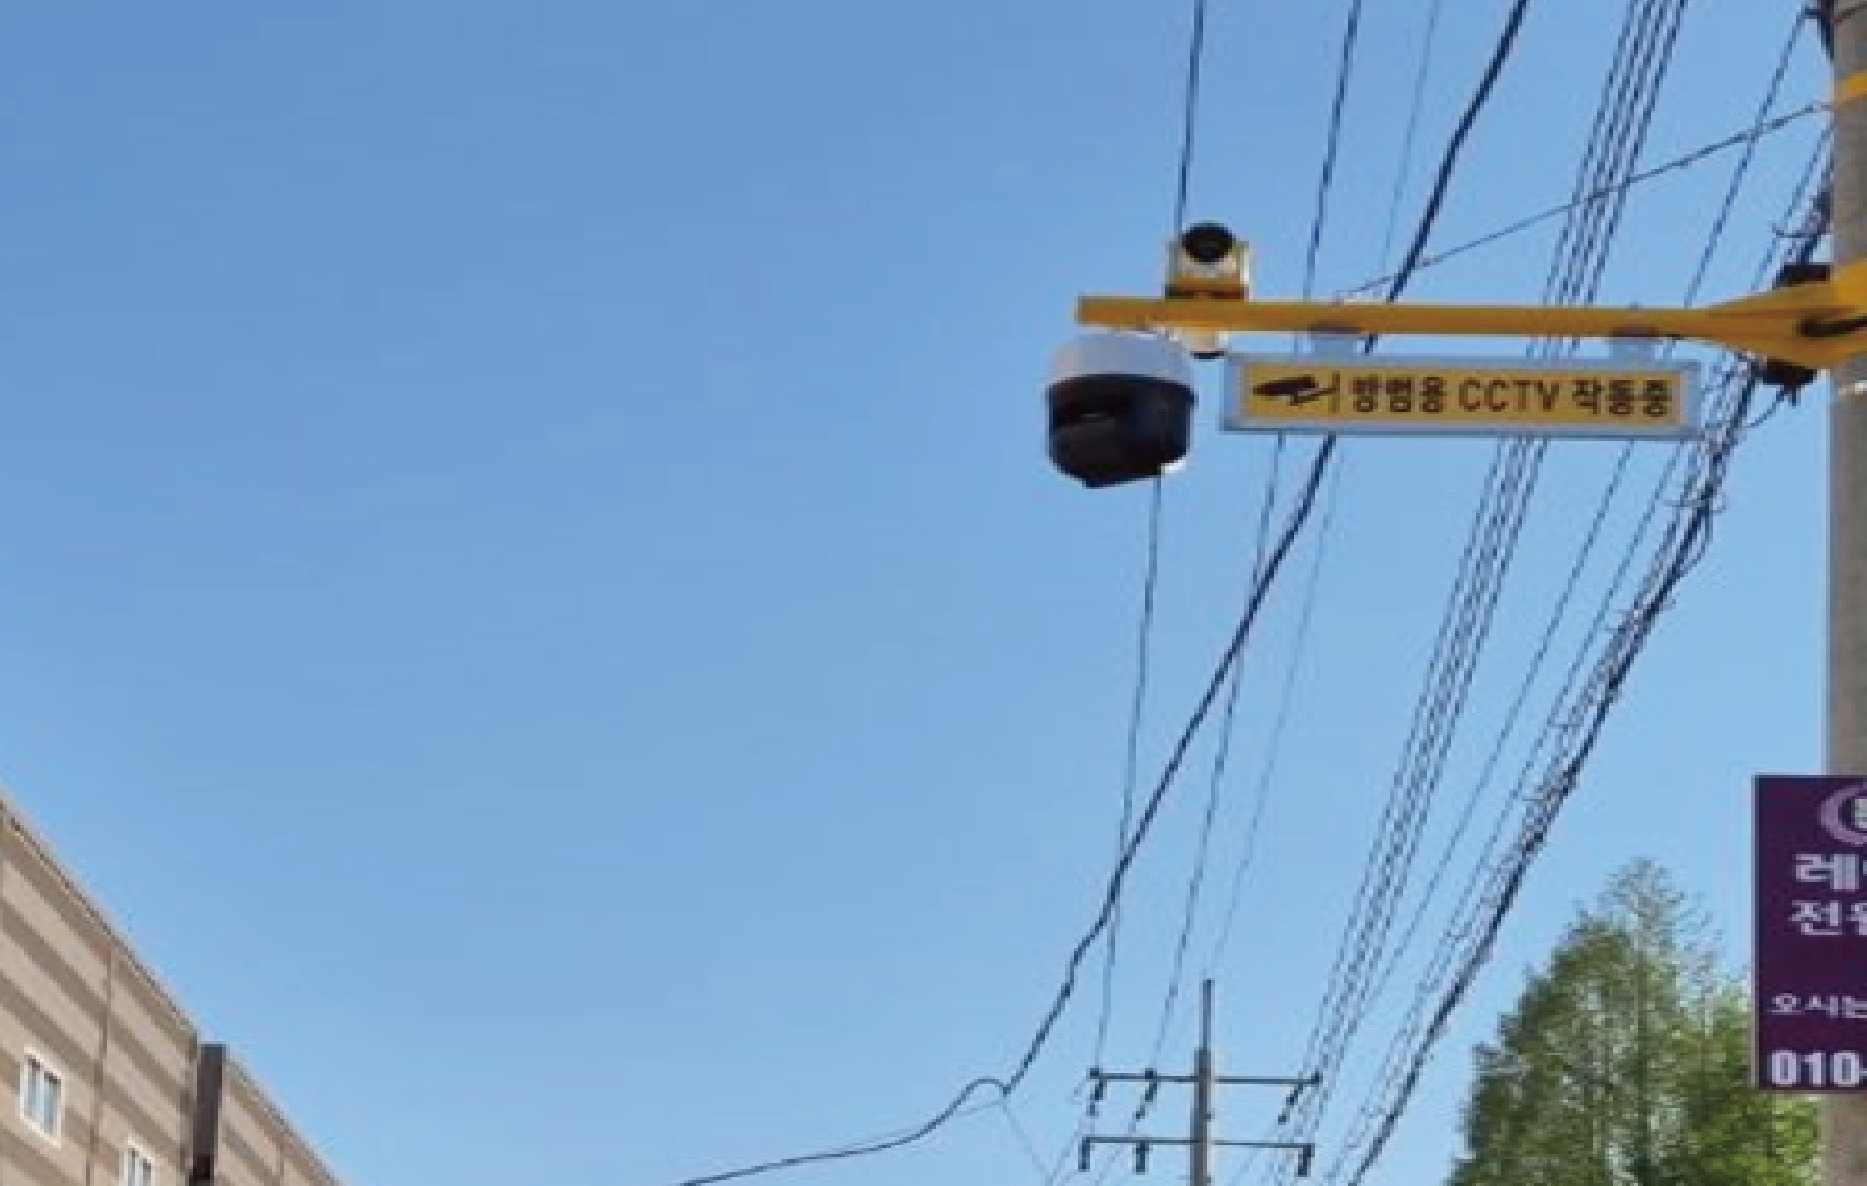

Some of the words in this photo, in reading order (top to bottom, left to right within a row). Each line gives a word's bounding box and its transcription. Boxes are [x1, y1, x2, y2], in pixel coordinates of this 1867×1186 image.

[1352, 373, 1447, 414] 방범용
[1457, 379, 1561, 413] CCTV
[1572, 377, 1673, 417] 작동중
